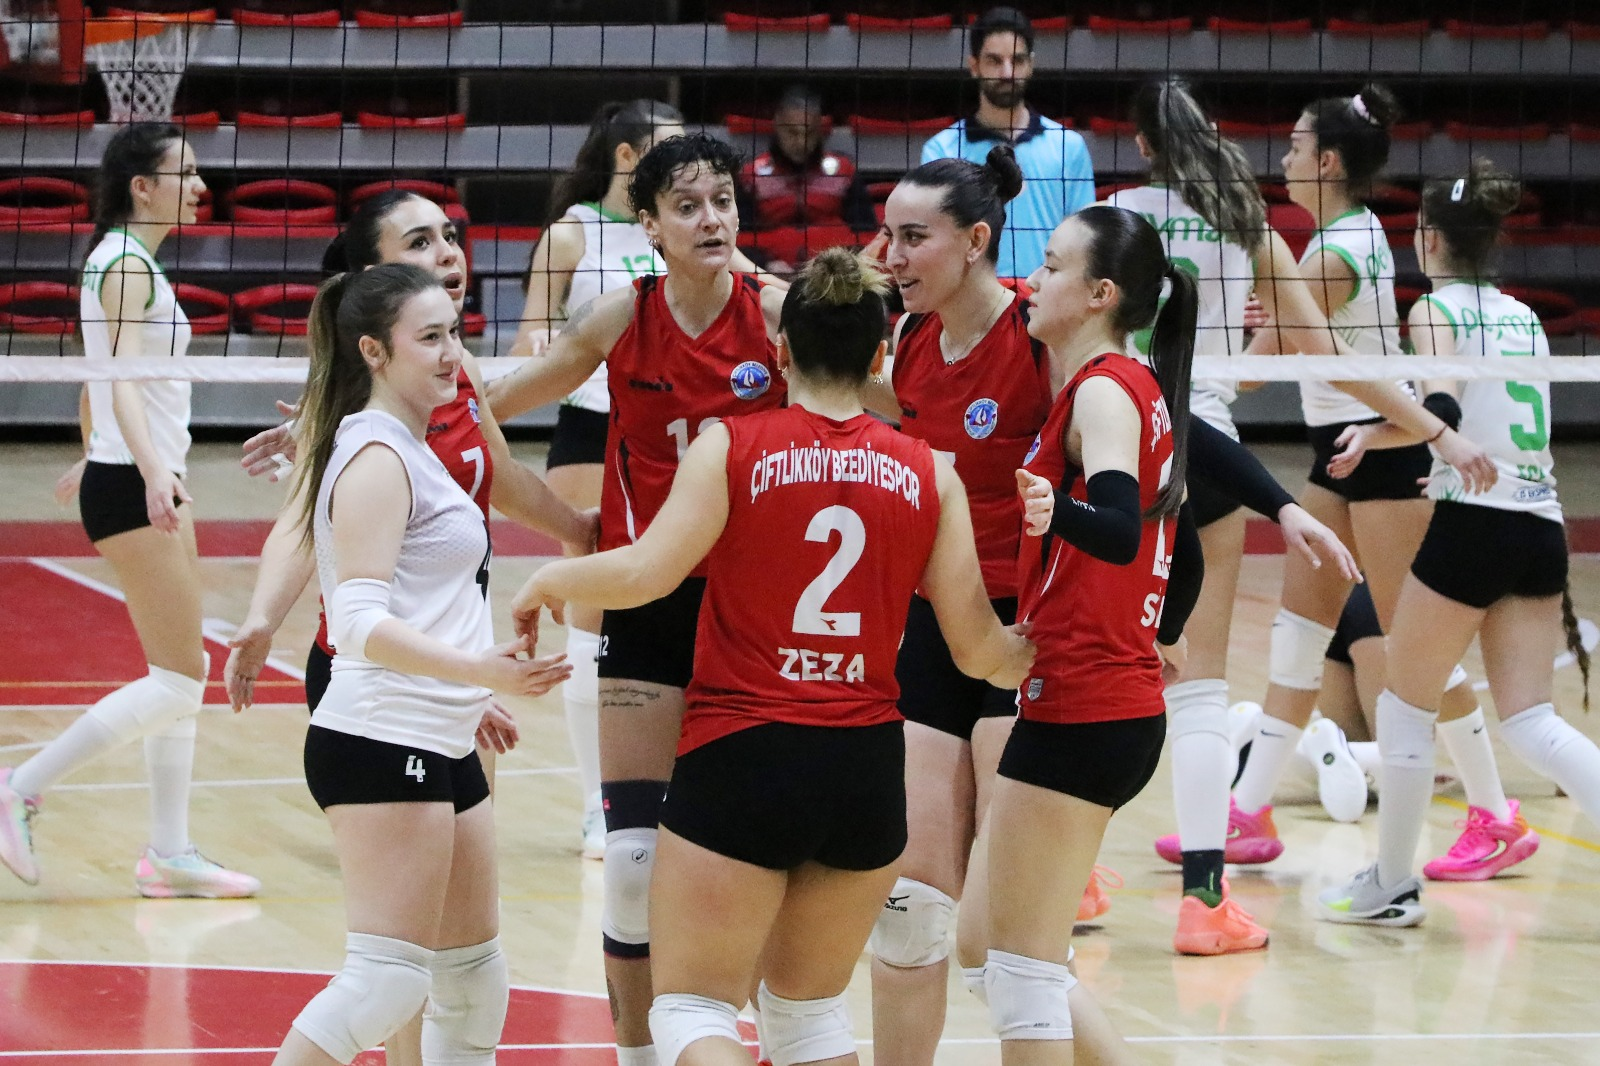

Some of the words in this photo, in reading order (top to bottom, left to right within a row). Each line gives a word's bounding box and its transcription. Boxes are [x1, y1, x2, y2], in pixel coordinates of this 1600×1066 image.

[1501, 350, 1548, 452] 5
[460, 445, 485, 500] 7
[750, 440, 831, 504] ÇİFTLİKKÖY
[791, 504, 867, 637] 2
[777, 646, 866, 683] ZEZA
[404, 754, 426, 783] 4
